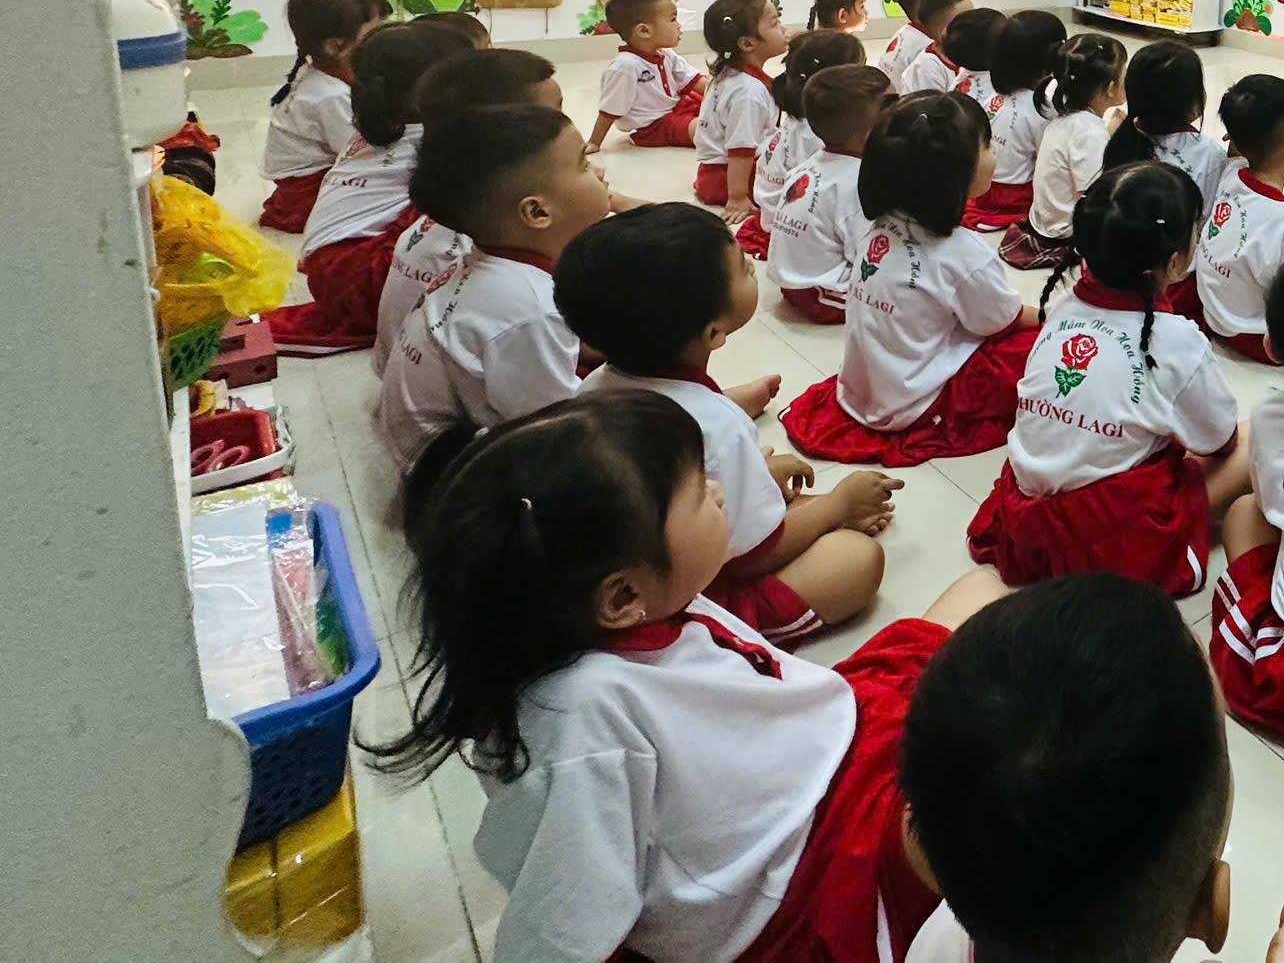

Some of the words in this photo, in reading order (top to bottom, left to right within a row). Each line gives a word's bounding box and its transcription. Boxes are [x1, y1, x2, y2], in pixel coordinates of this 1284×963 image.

[783, 215, 808, 231] LAGI
[866, 295, 895, 314] LAGI
[1018, 397, 1074, 425] HƯỜNG
[1078, 414, 1123, 438] LAGI
